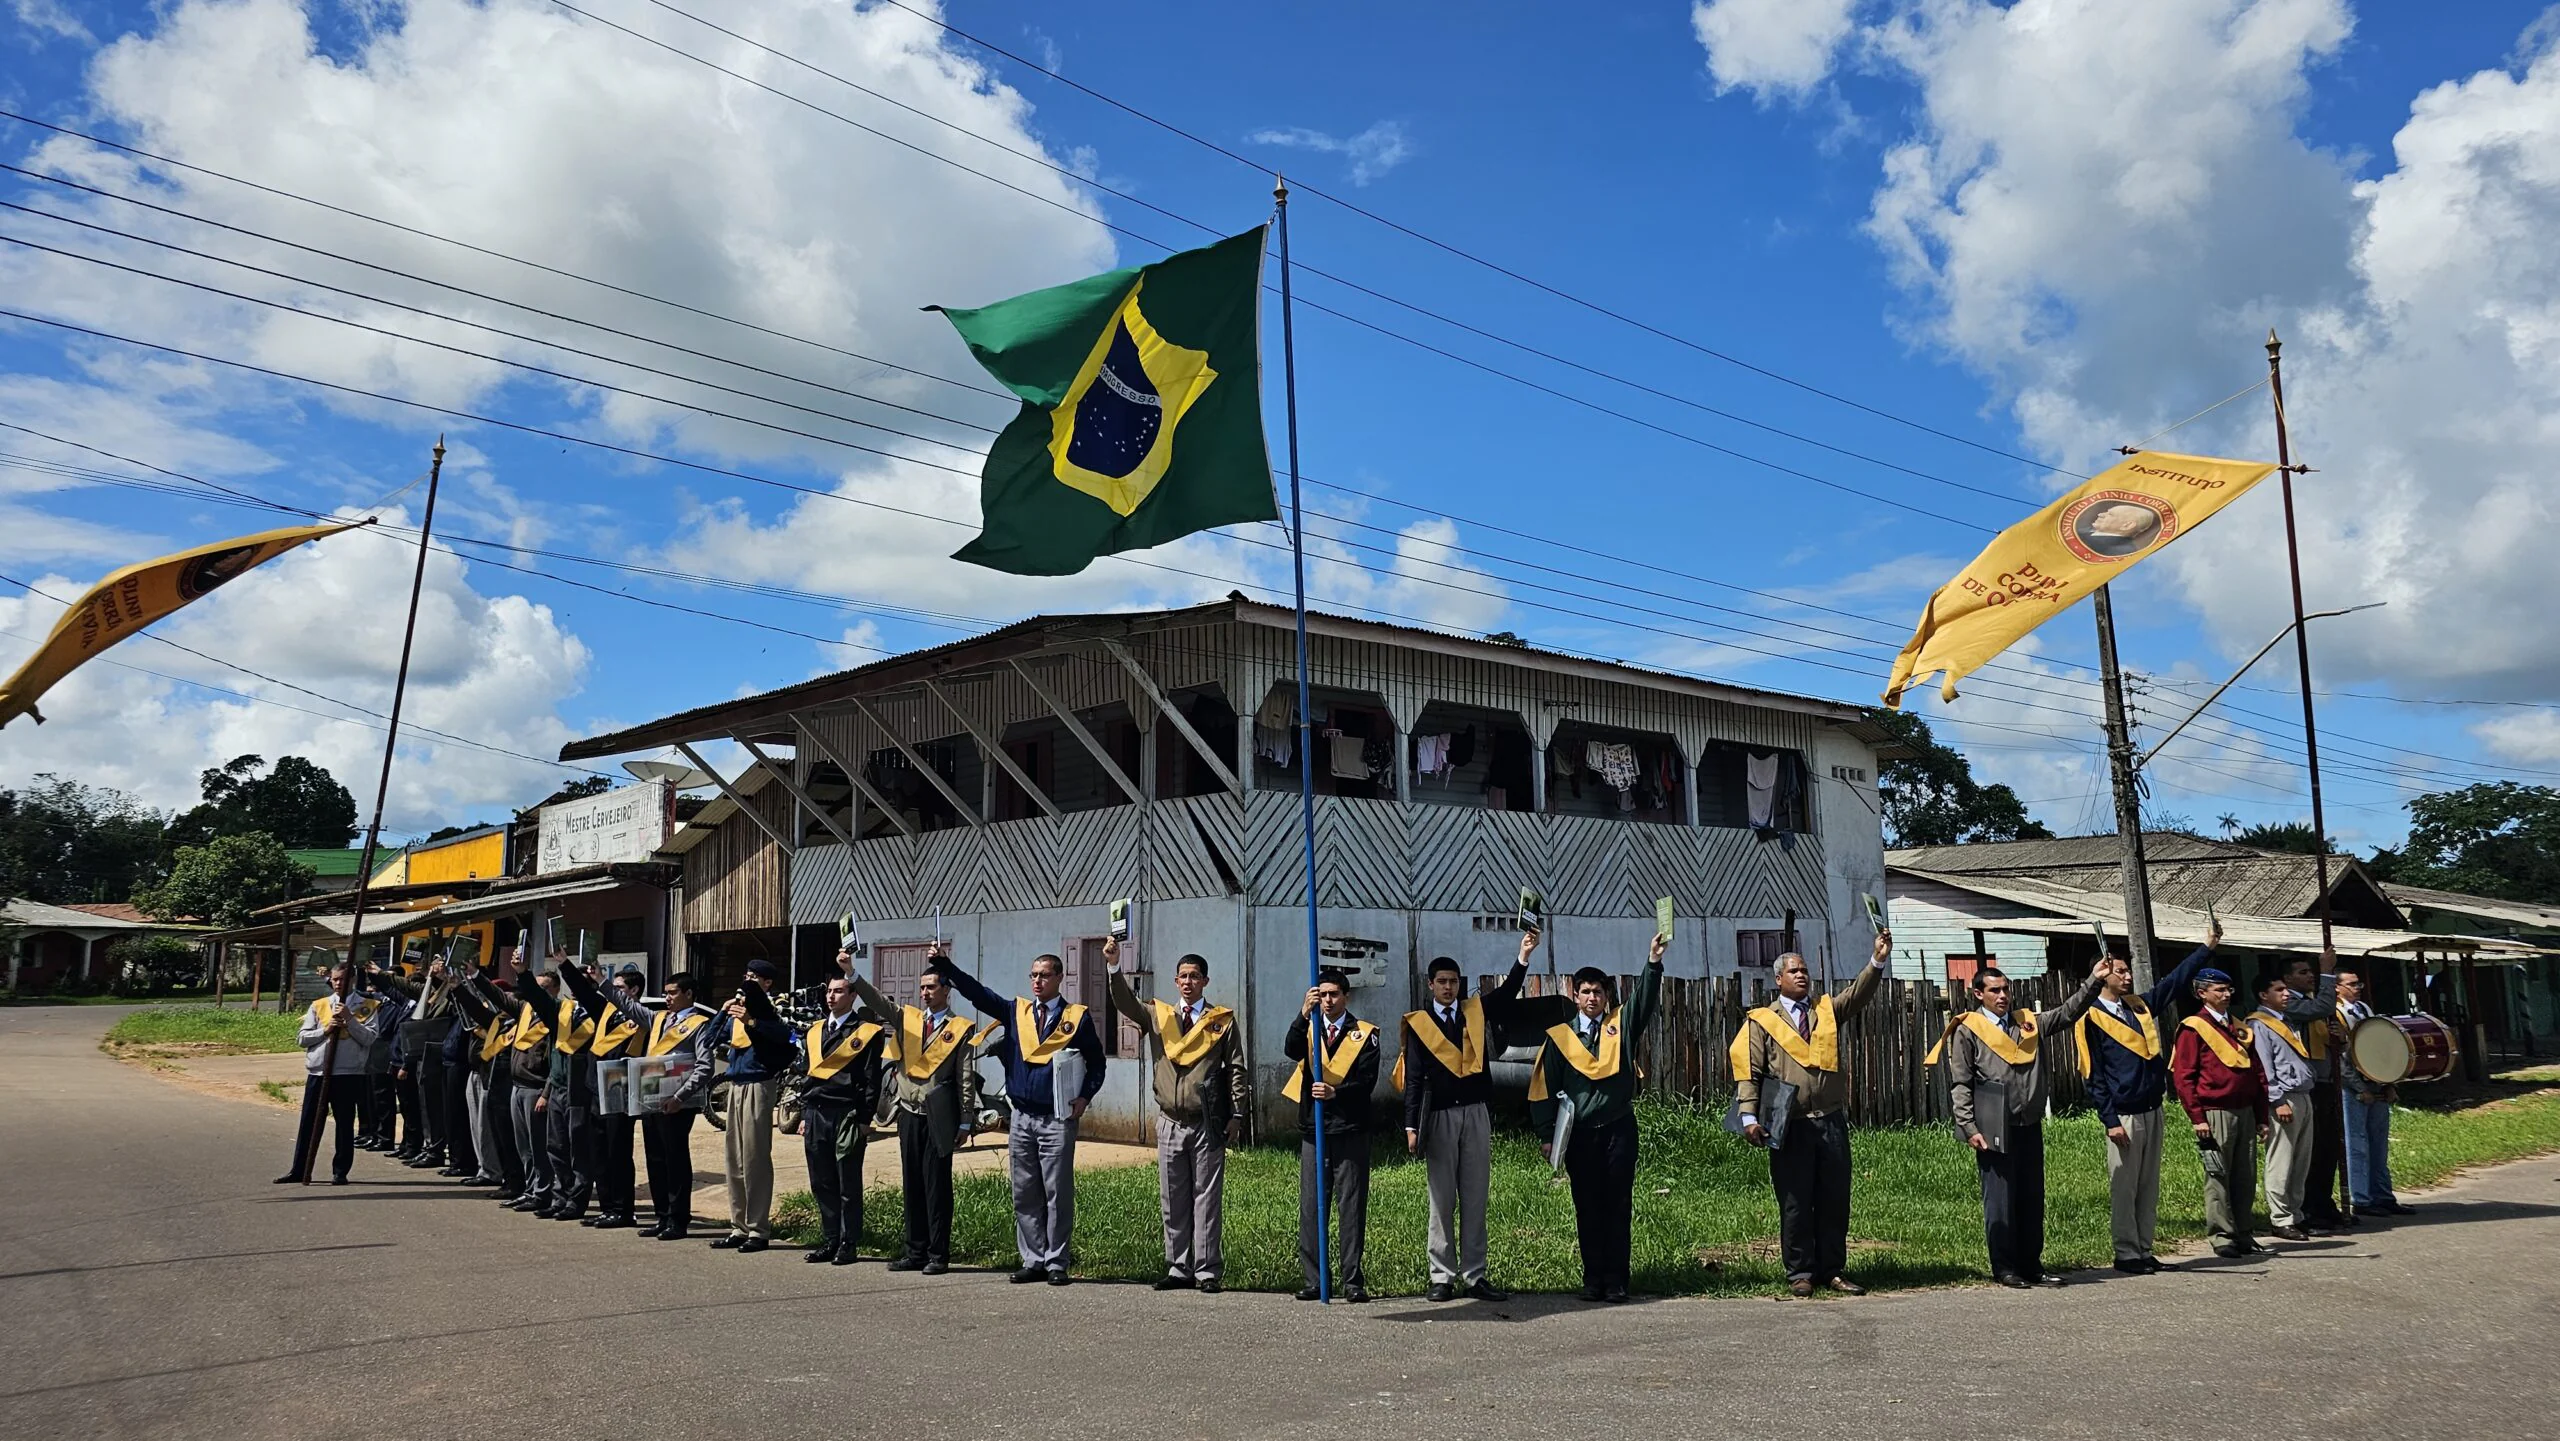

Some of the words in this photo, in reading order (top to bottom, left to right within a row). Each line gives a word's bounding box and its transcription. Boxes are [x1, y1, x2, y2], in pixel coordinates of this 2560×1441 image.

[2128, 464, 2226, 490] INSTITUTO
[2088, 491, 2134, 503] PLINIO
[1961, 577, 1988, 597] DE
[566, 812, 590, 834] MESTRE
[592, 805, 632, 829] CERVEJEIRO
